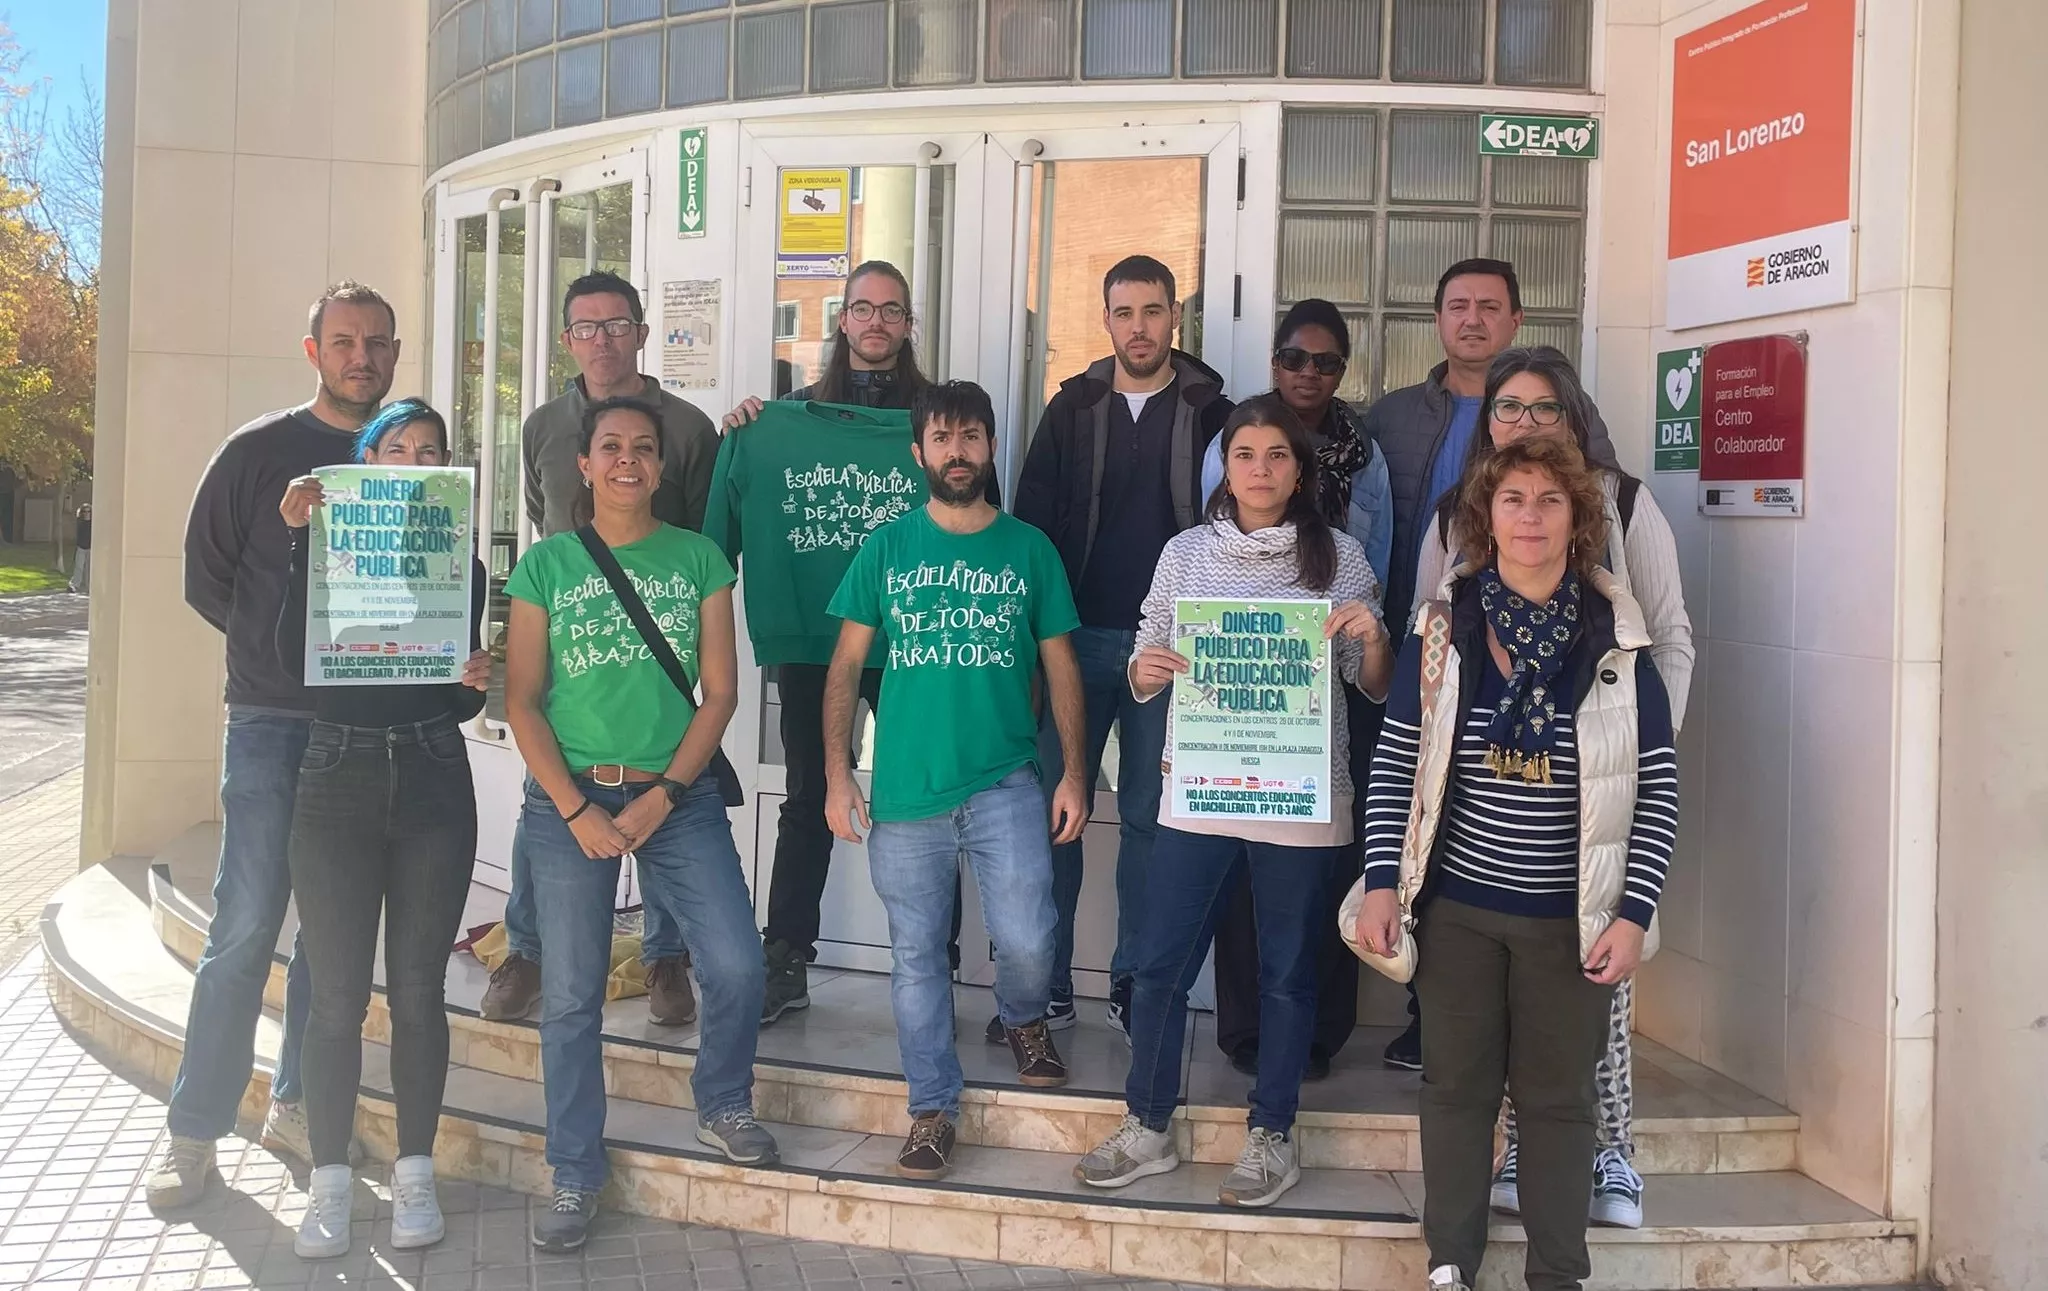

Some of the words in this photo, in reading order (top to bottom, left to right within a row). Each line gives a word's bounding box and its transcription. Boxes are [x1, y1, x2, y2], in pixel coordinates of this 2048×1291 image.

[1506, 124, 1560, 148] DEA
[1686, 139, 1720, 167] San
[1726, 112, 1805, 156] Lorenzo
[687, 160, 698, 211] DEA
[1768, 244, 1822, 268] GOBIERNO
[1768, 269, 1782, 284] DE
[1716, 366, 1757, 382] Formación
[1716, 388, 1733, 402] para
[1734, 387, 1742, 399] el
[1744, 385, 1775, 400] Empleo
[1715, 409, 1753, 426] Centro
[1661, 422, 1694, 445] DEA
[1714, 434, 1786, 454] Colaborador
[360, 478, 424, 502] DINERO
[786, 468, 851, 490] ESCUELA
[855, 470, 917, 494] PÚBLICA:
[1764, 487, 1790, 495] GOBIERNO
[408, 505, 452, 528] PARA
[804, 506, 827, 521] DE
[837, 505, 900, 524] TOD@S
[330, 529, 351, 551] LA
[794, 530, 843, 549] PARA
[887, 565, 959, 595] ESCUELA
[554, 577, 614, 611] ESCUEL
[570, 618, 600, 641] DE
[901, 610, 933, 634] DE
[937, 607, 1011, 634] TOD@S
[1222, 611, 1284, 635] DINERO
[566, 646, 620, 673] PARA
[890, 645, 939, 671] PARA
[942, 642, 1015, 668] TOD@S
[1268, 638, 1312, 660] PARA
[320, 656, 332, 667] NO
[334, 656, 340, 666] A
[340, 656, 356, 666] LOS
[358, 656, 406, 667] CONCIERTOS
[408, 656, 455, 668] EDUCATIVOS
[1194, 662, 1215, 684] LA
[324, 668, 335, 679] EN
[336, 668, 394, 678] BACHILLERATO
[398, 668, 408, 678] FP
[409, 668, 414, 678] Y
[416, 668, 429, 678] 0-3
[1180, 714, 1232, 724] CONCENTRACIONES
[1233, 716, 1240, 724] EN
[1241, 716, 1252, 724] LOS
[1252, 716, 1278, 724] CENTROS
[1288, 717, 1294, 726] DE
[1228, 730, 1231, 738] Y
[1237, 730, 1244, 738] DE
[1224, 743, 1229, 751] DE
[1230, 744, 1257, 752] NOVIEMBRE
[1268, 744, 1275, 752] EN
[1276, 745, 1281, 753] LA
[1282, 745, 1297, 754] PLAZA
[1240, 756, 1261, 766] HUESCA
[1186, 788, 1198, 800] NO
[1199, 789, 1204, 800] A
[1205, 790, 1220, 800] LOS
[1220, 790, 1268, 802] CONCIERTOS
[1269, 792, 1316, 804] EDUCATIVOS
[1190, 801, 1200, 812] EN
[1200, 802, 1256, 814] BACHILLERATO
[1261, 804, 1270, 814] FP
[1271, 804, 1276, 814] Y
[1278, 804, 1290, 815] 0-3
